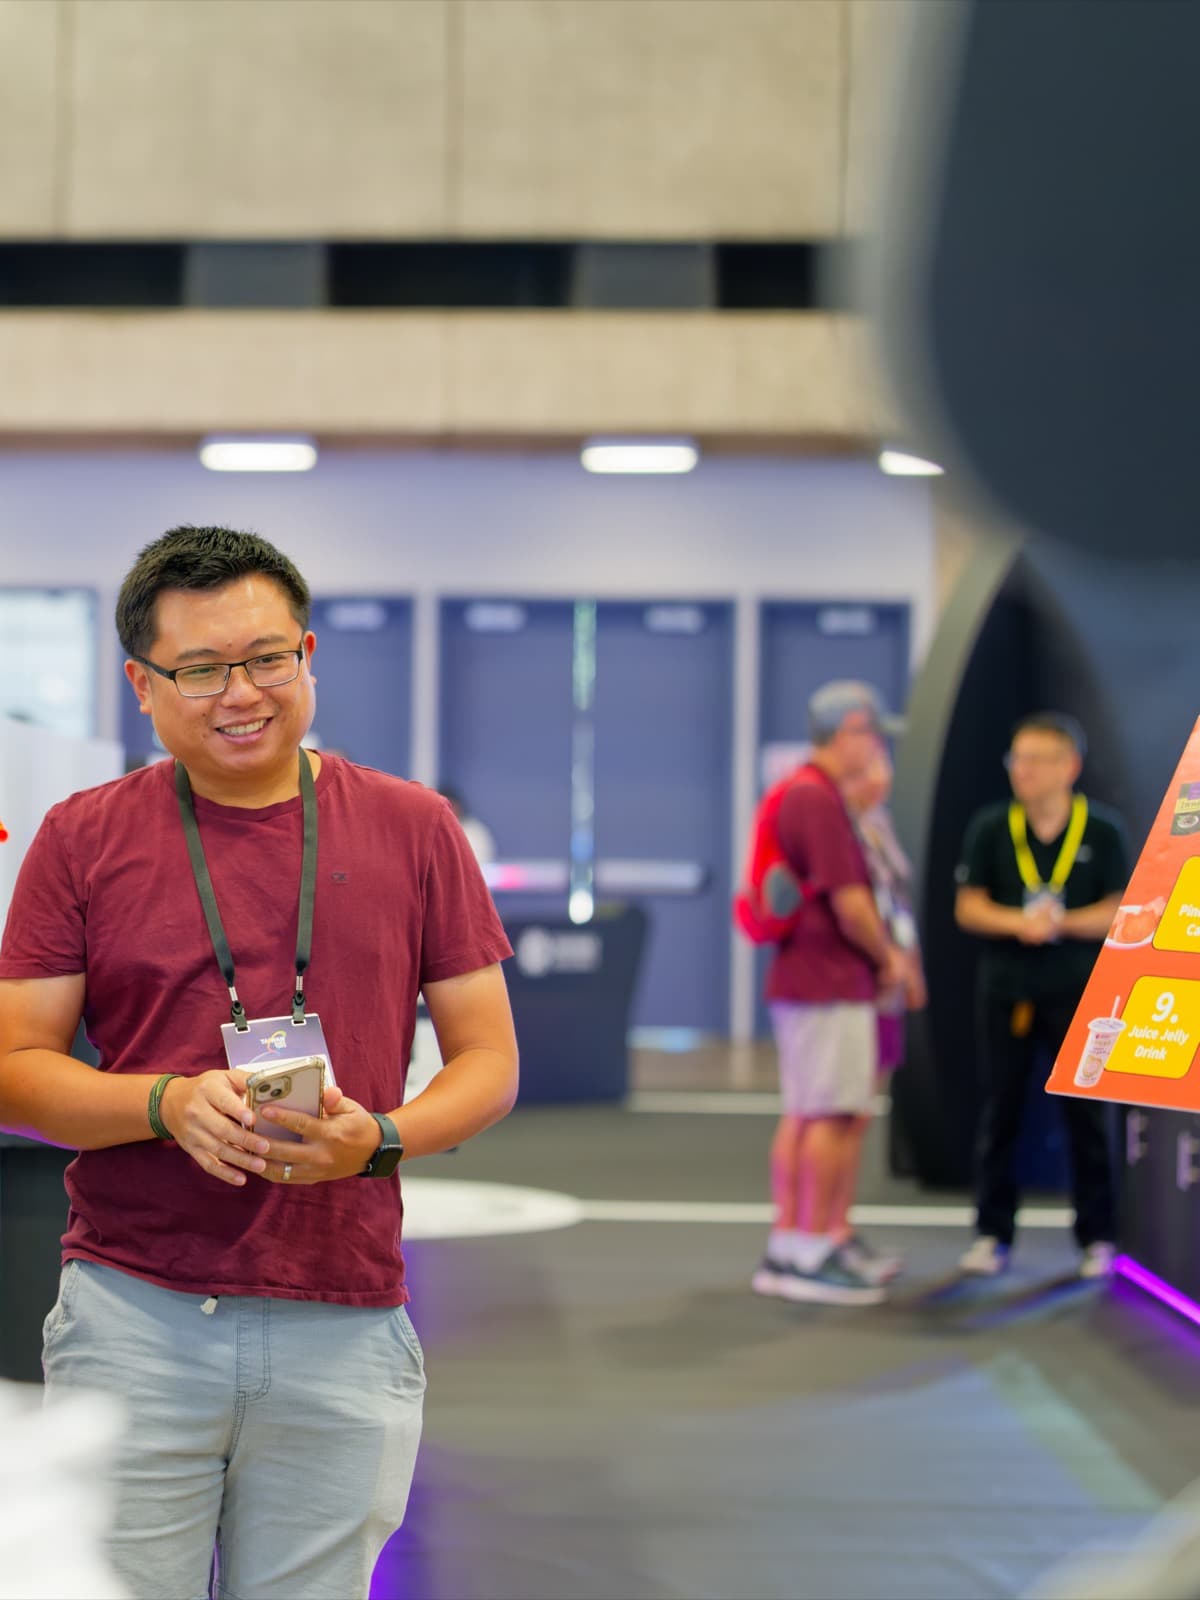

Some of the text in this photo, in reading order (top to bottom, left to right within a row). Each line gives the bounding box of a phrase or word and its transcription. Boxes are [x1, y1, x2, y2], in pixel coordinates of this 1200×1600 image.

[1151, 991, 1179, 1024] 9.
[1128, 1025, 1190, 1046] Juice Jelly
[1134, 1045, 1167, 1061] Drink
